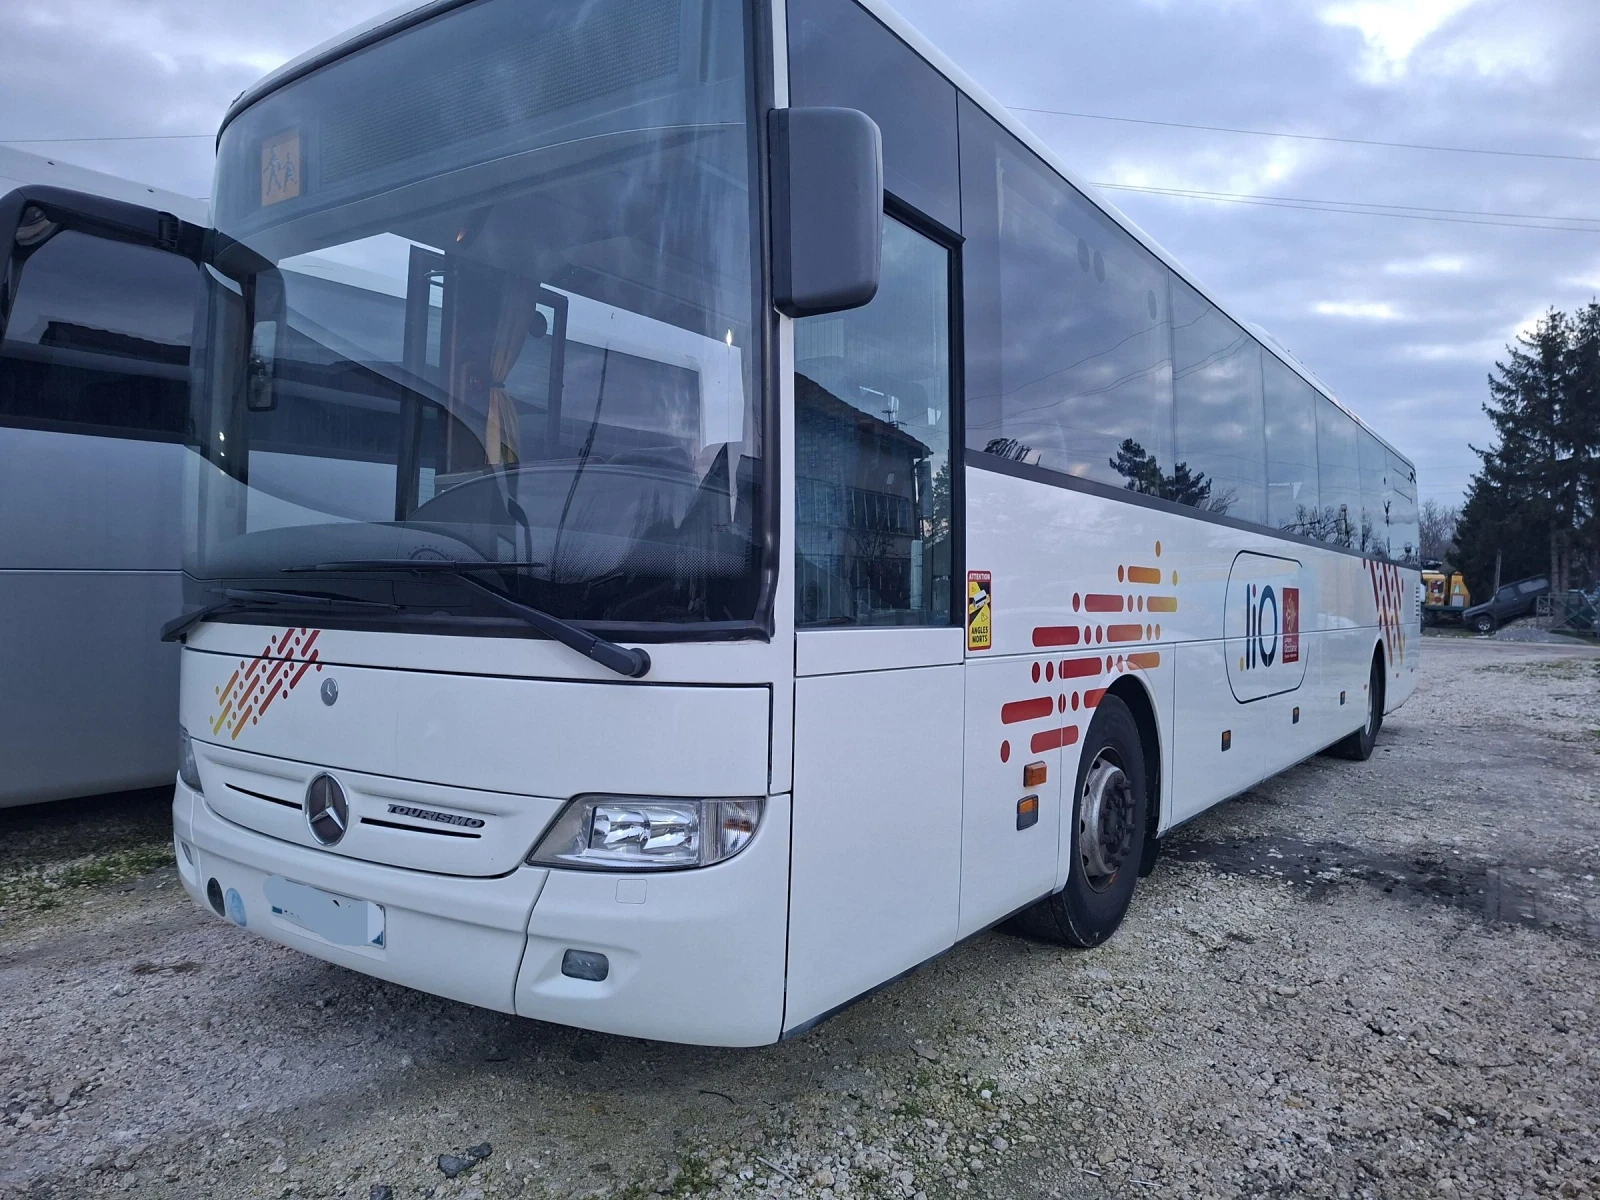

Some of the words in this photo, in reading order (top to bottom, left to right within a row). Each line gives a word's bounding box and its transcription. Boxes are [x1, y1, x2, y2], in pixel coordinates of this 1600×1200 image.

[971, 625, 989, 634] ANGLES
[972, 634, 988, 643] MORTS
[387, 804, 484, 829] TOURISMO
